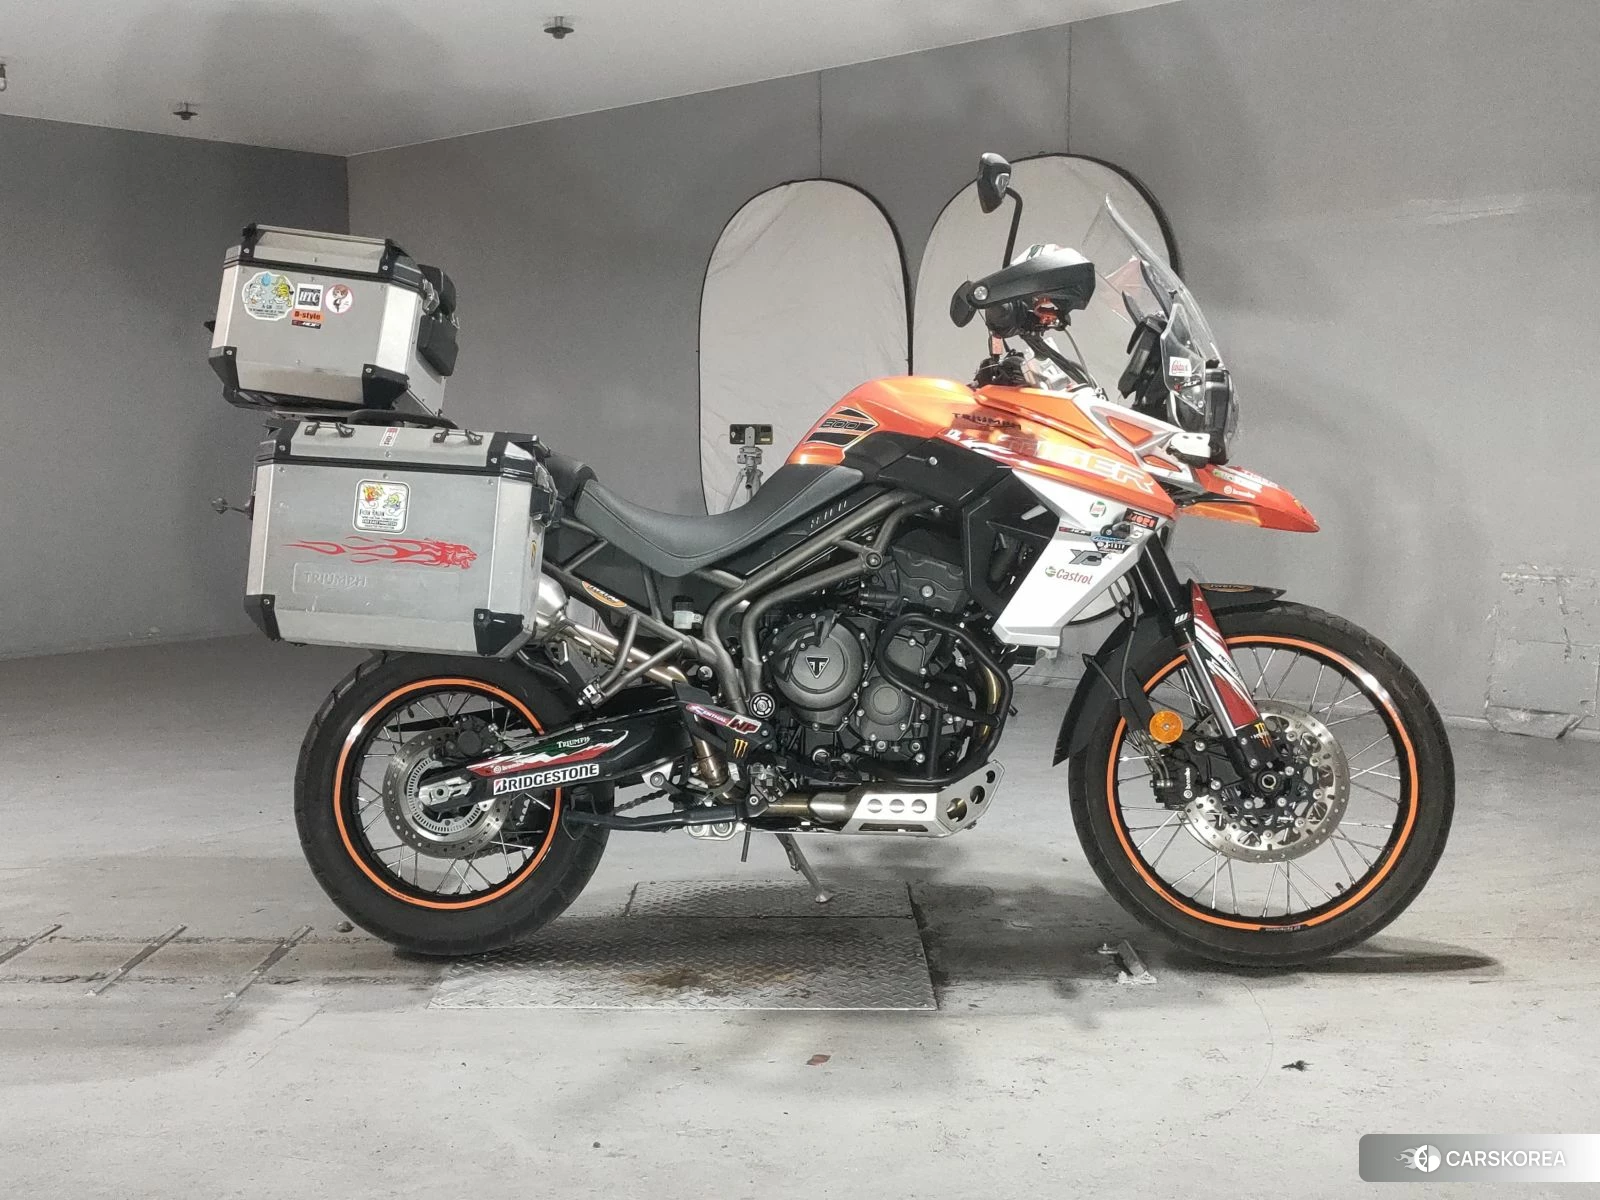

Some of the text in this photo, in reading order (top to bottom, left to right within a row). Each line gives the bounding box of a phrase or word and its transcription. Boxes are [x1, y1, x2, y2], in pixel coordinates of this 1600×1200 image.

[303, 571, 367, 589] TRIUMPH
[1056, 568, 1093, 585] Castrol
[556, 735, 591, 748] TRIUMPH
[494, 765, 599, 794] BRIDGESTONE
